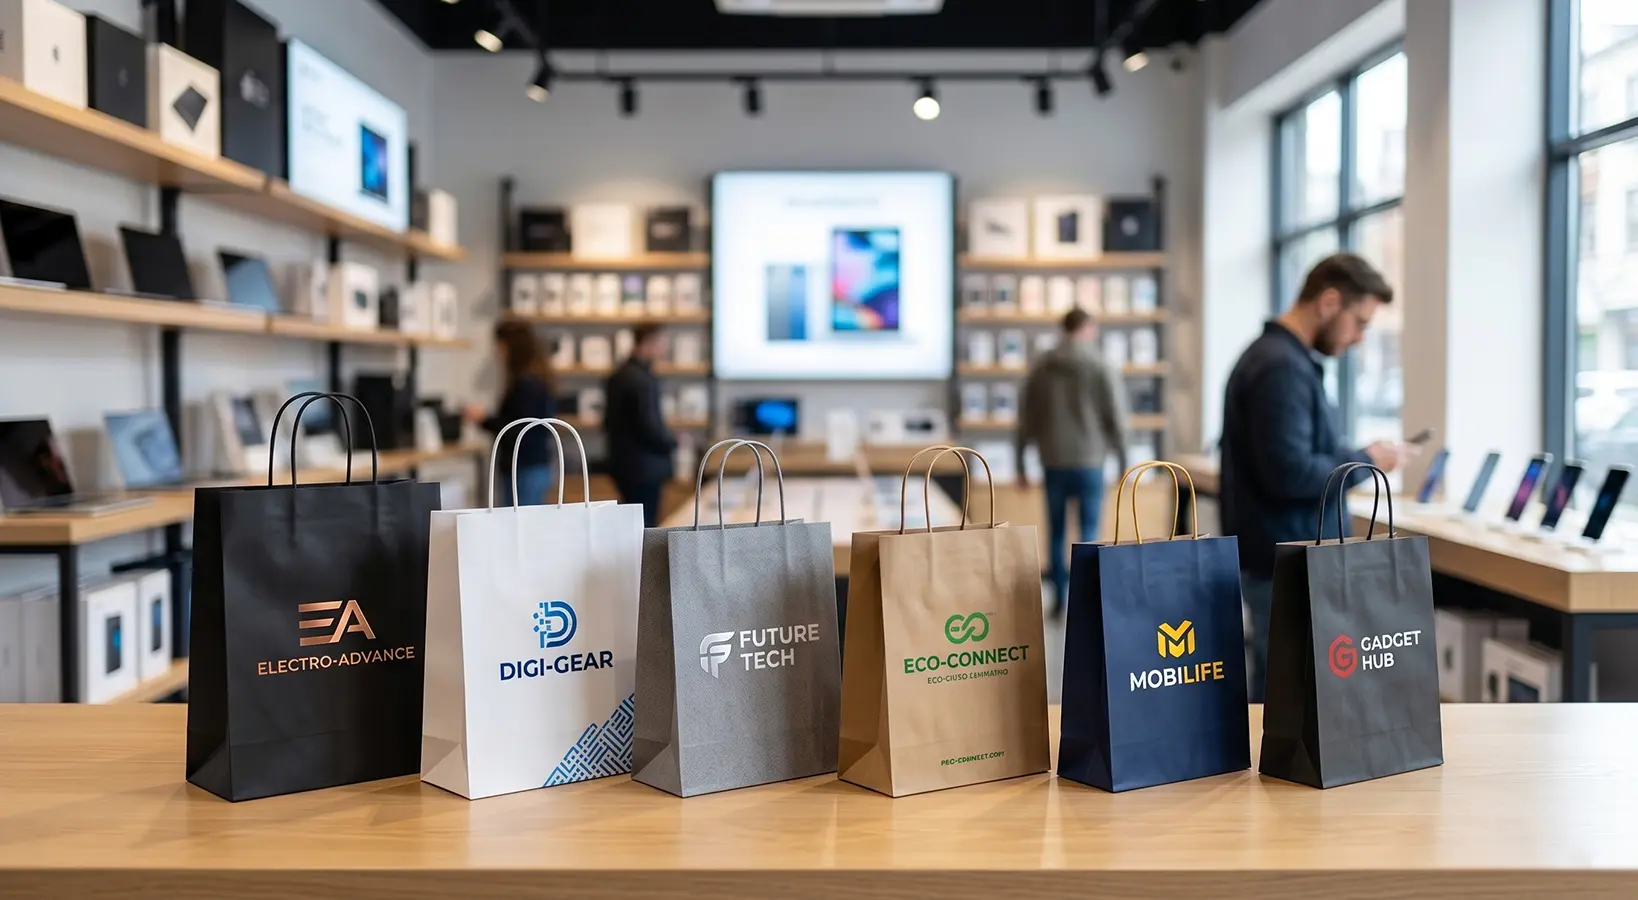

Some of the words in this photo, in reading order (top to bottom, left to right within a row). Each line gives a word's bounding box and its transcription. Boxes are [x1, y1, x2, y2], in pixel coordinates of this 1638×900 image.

[739, 623, 820, 648] FUTURE
[1360, 630, 1421, 651] GADGET
[257, 646, 415, 675] ELECTRO-ADVANCE
[500, 650, 613, 681] DIGI-GEAR
[740, 648, 795, 671] TECH
[903, 645, 1029, 674] ECO-CONNECT
[1362, 652, 1395, 670] HUB
[1130, 661, 1225, 692] MOBILIFE
